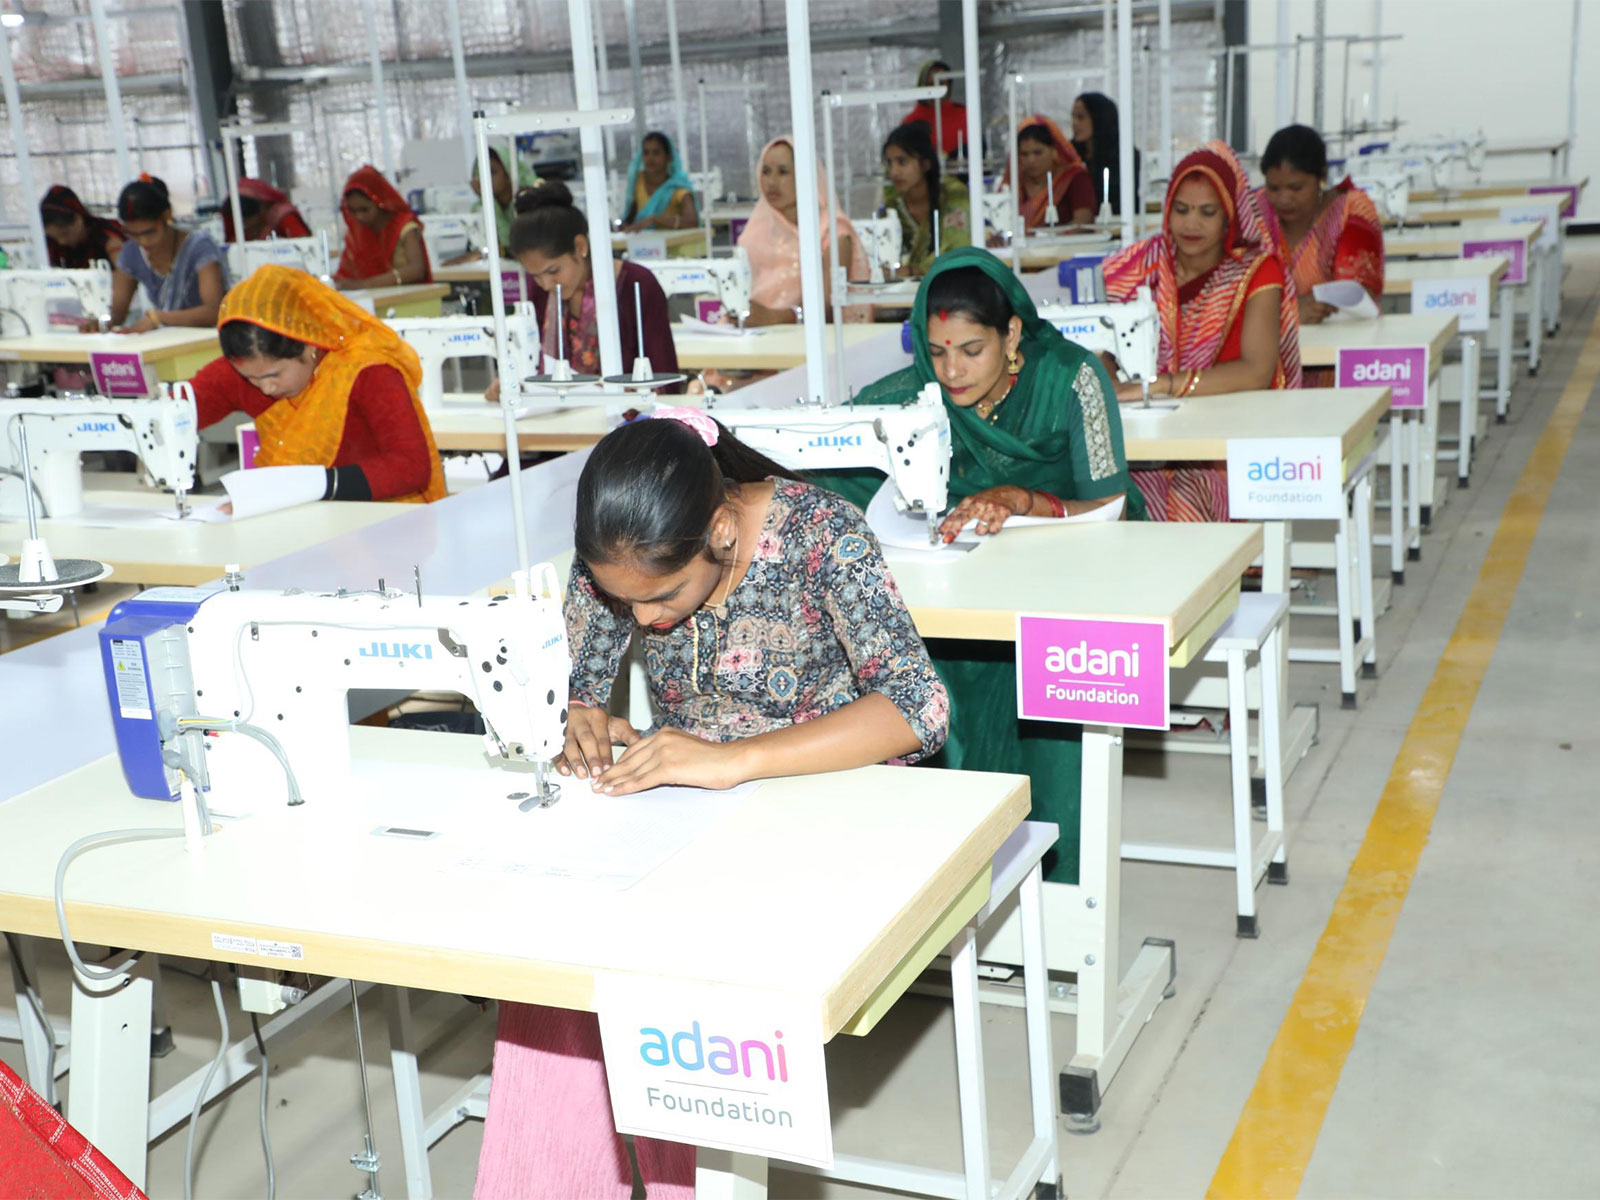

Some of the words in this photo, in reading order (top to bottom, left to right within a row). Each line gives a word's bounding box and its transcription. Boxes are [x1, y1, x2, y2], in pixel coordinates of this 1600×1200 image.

[1424, 289, 1477, 308] adani
[1352, 357, 1412, 381] adani
[77, 422, 116, 432] JUKI
[808, 435, 862, 447] JUKI
[1247, 455, 1322, 481] adani
[1247, 491, 1322, 503] Foundation
[359, 642, 433, 660] JUKI
[541, 633, 563, 650] JUKI
[1044, 640, 1140, 678] adani
[1045, 684, 1140, 706] Foundation
[639, 1020, 789, 1083] adani
[646, 1086, 793, 1128] Foundation
